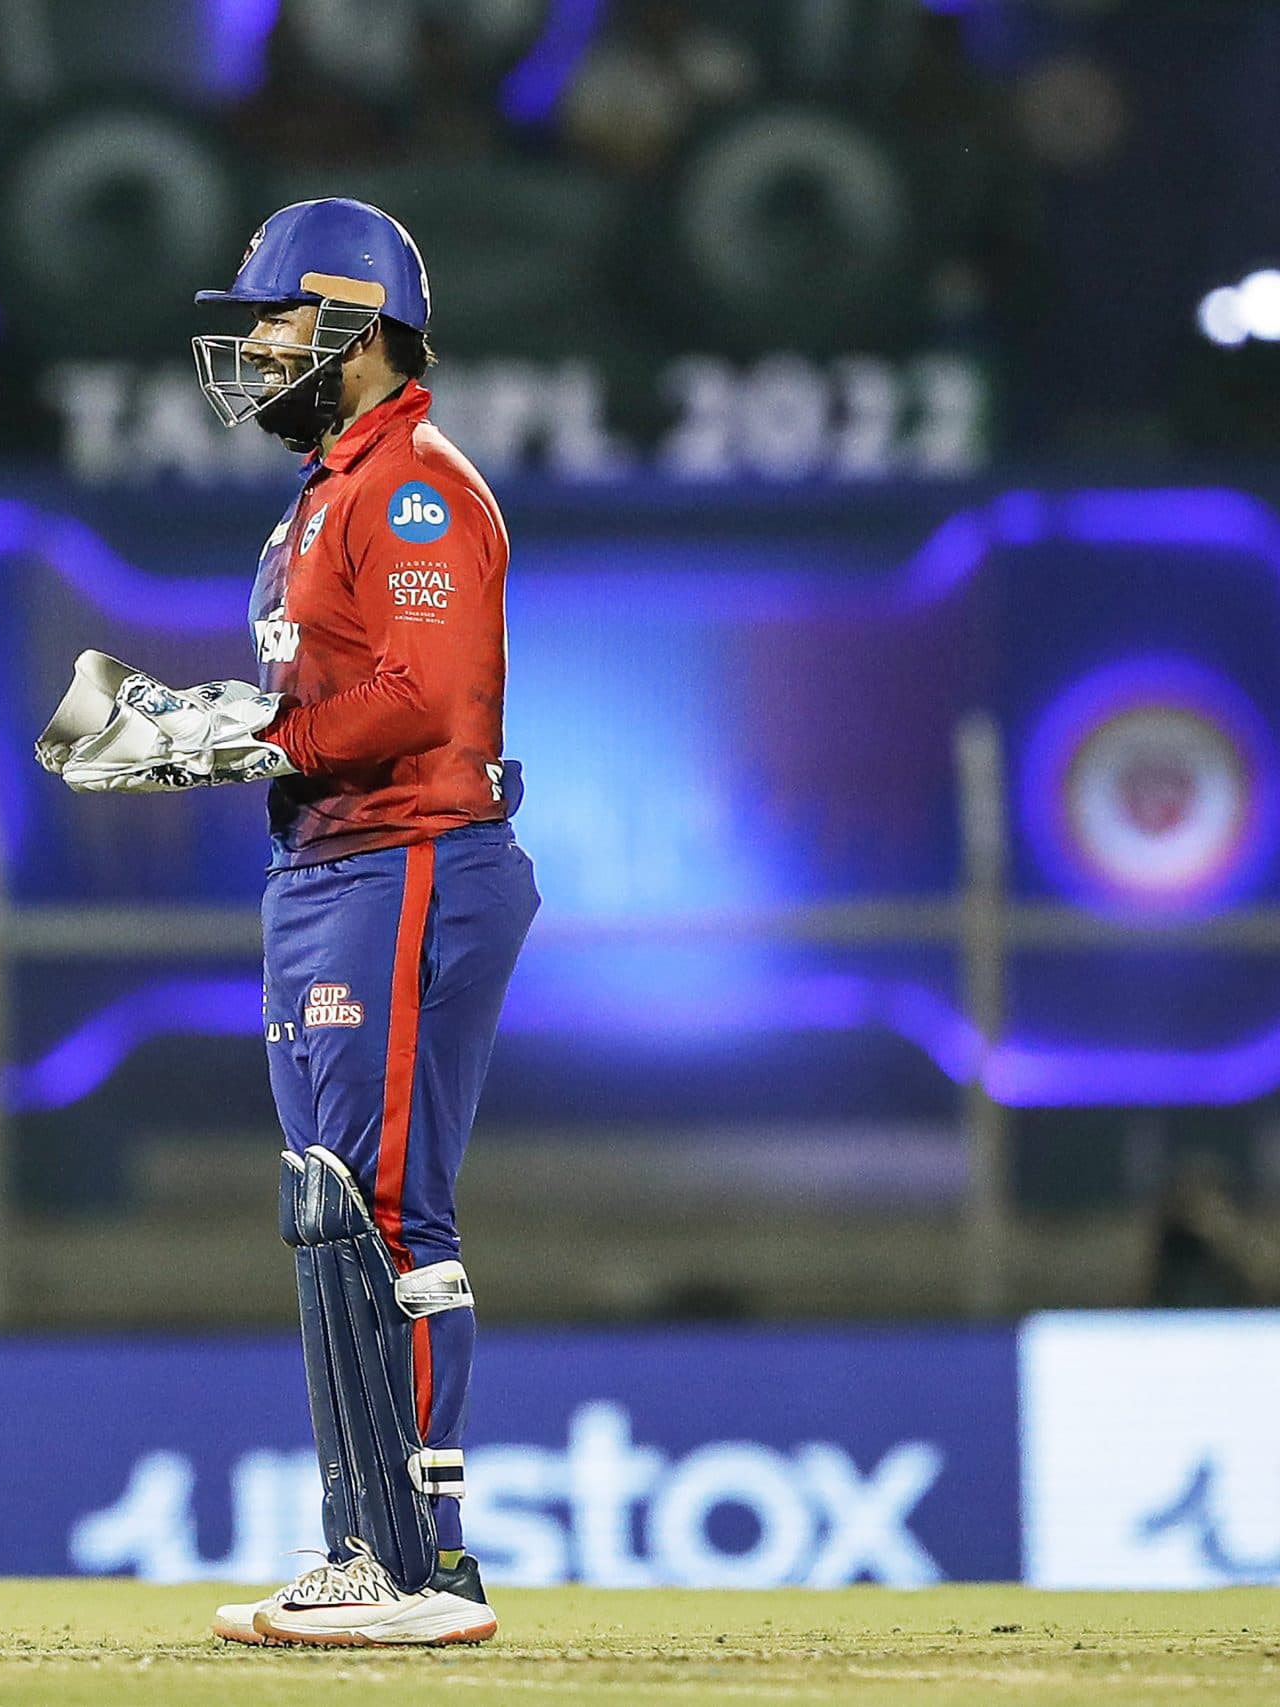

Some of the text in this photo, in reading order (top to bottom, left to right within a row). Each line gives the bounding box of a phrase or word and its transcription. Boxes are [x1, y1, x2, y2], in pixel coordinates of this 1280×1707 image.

[393, 493, 445, 525] Jio
[388, 570, 457, 592] ROYAL
[394, 588, 448, 609] STAG
[310, 986, 348, 1006] CUP
[72, 1402, 942, 1588] ustox
